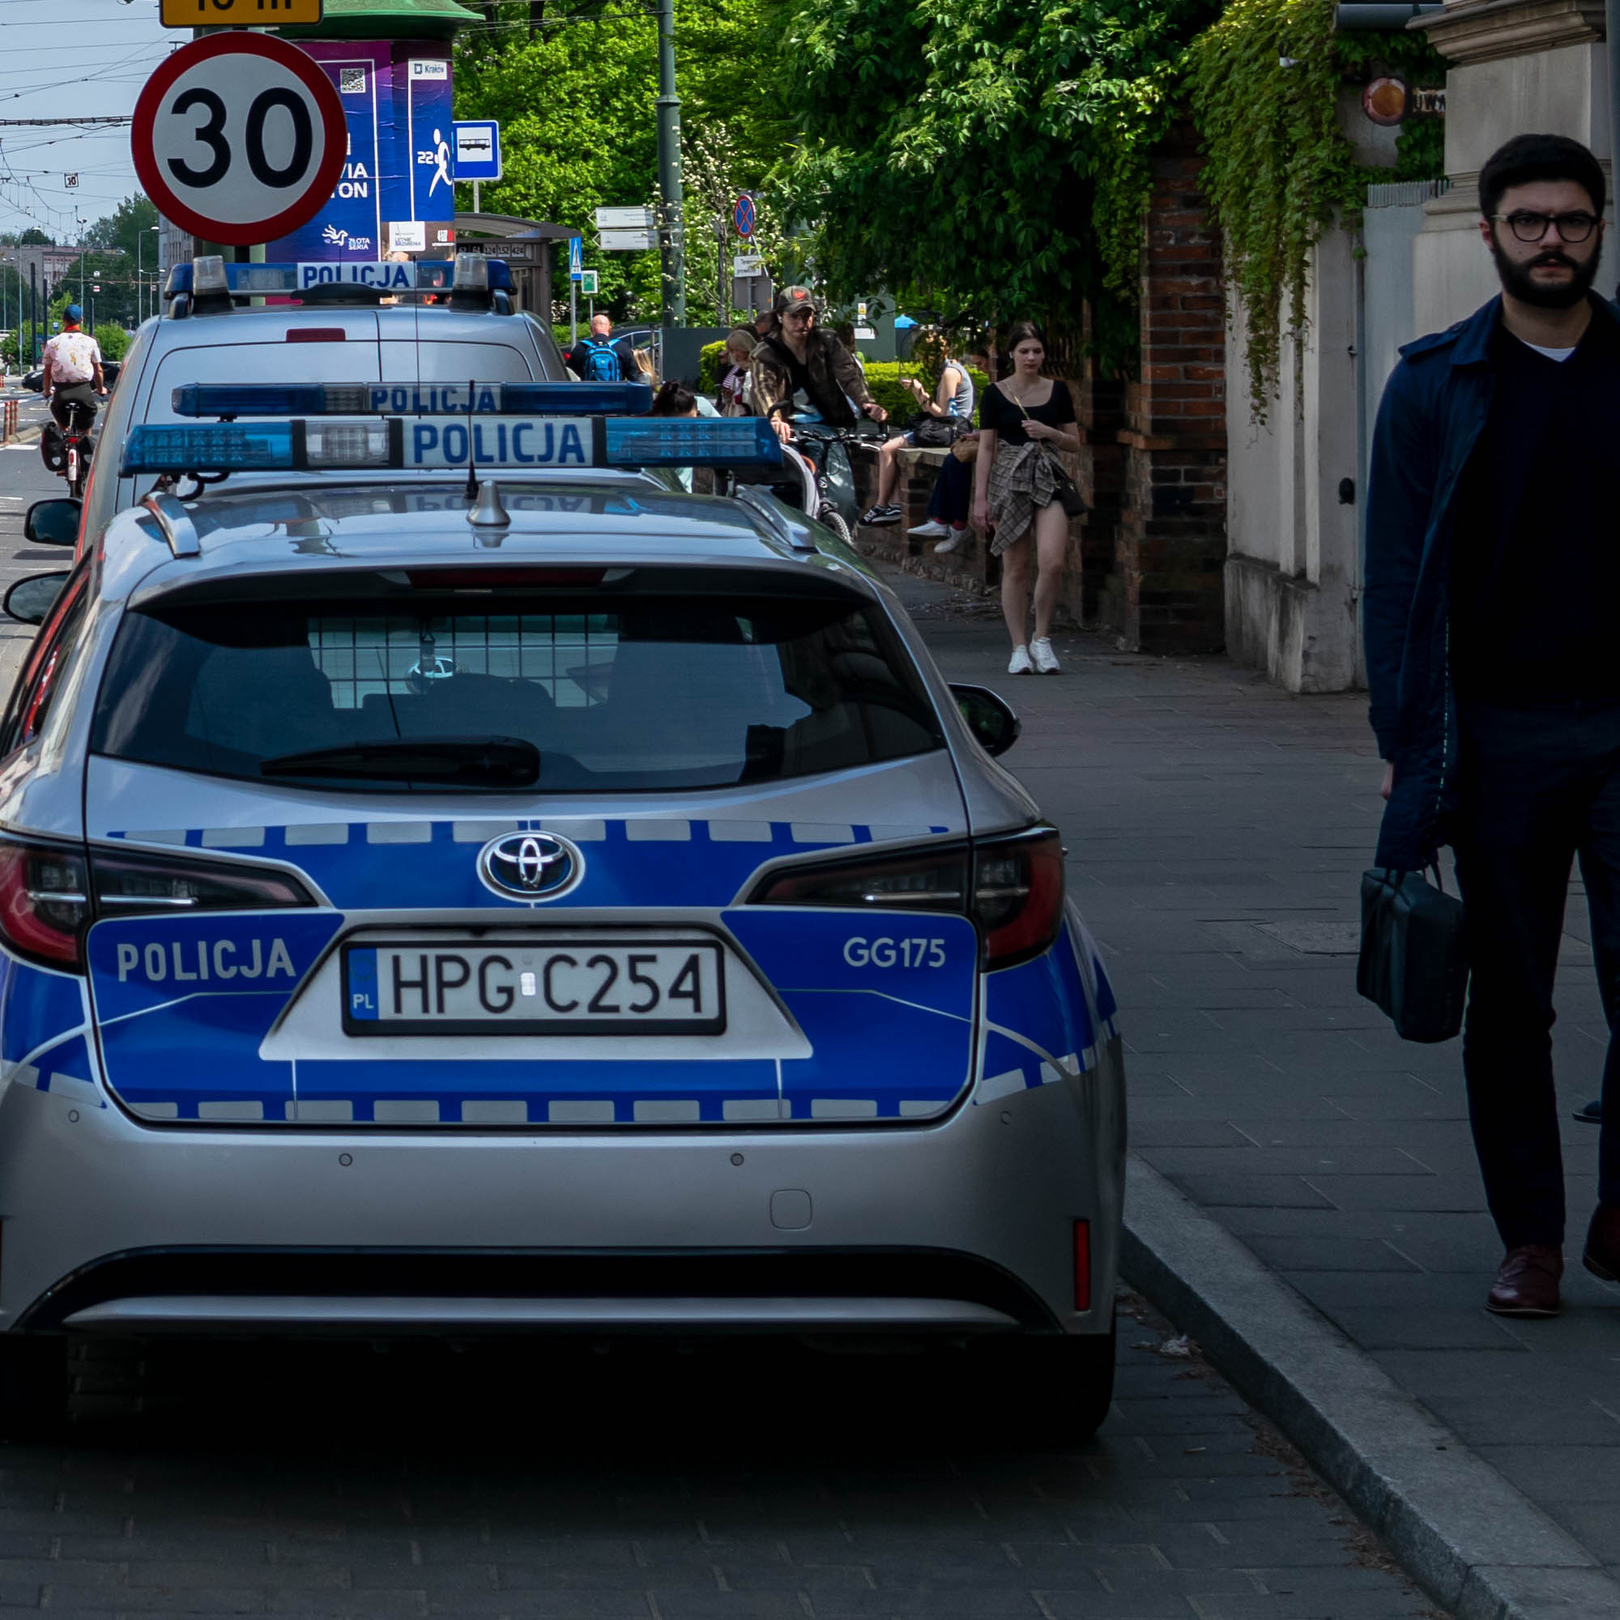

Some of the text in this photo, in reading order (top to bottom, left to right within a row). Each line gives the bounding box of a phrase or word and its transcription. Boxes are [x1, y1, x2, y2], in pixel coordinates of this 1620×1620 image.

[167, 86, 313, 189] 30
[331, 182, 368, 199] ON
[303, 265, 410, 289] POLICJA
[371, 386, 497, 413] POLICJA
[413, 422, 586, 464] POLICJA
[116, 938, 296, 983] POLICJA
[843, 936, 946, 968] GG175
[391, 954, 702, 1015] HPG C254
[352, 993, 375, 1010] PL
